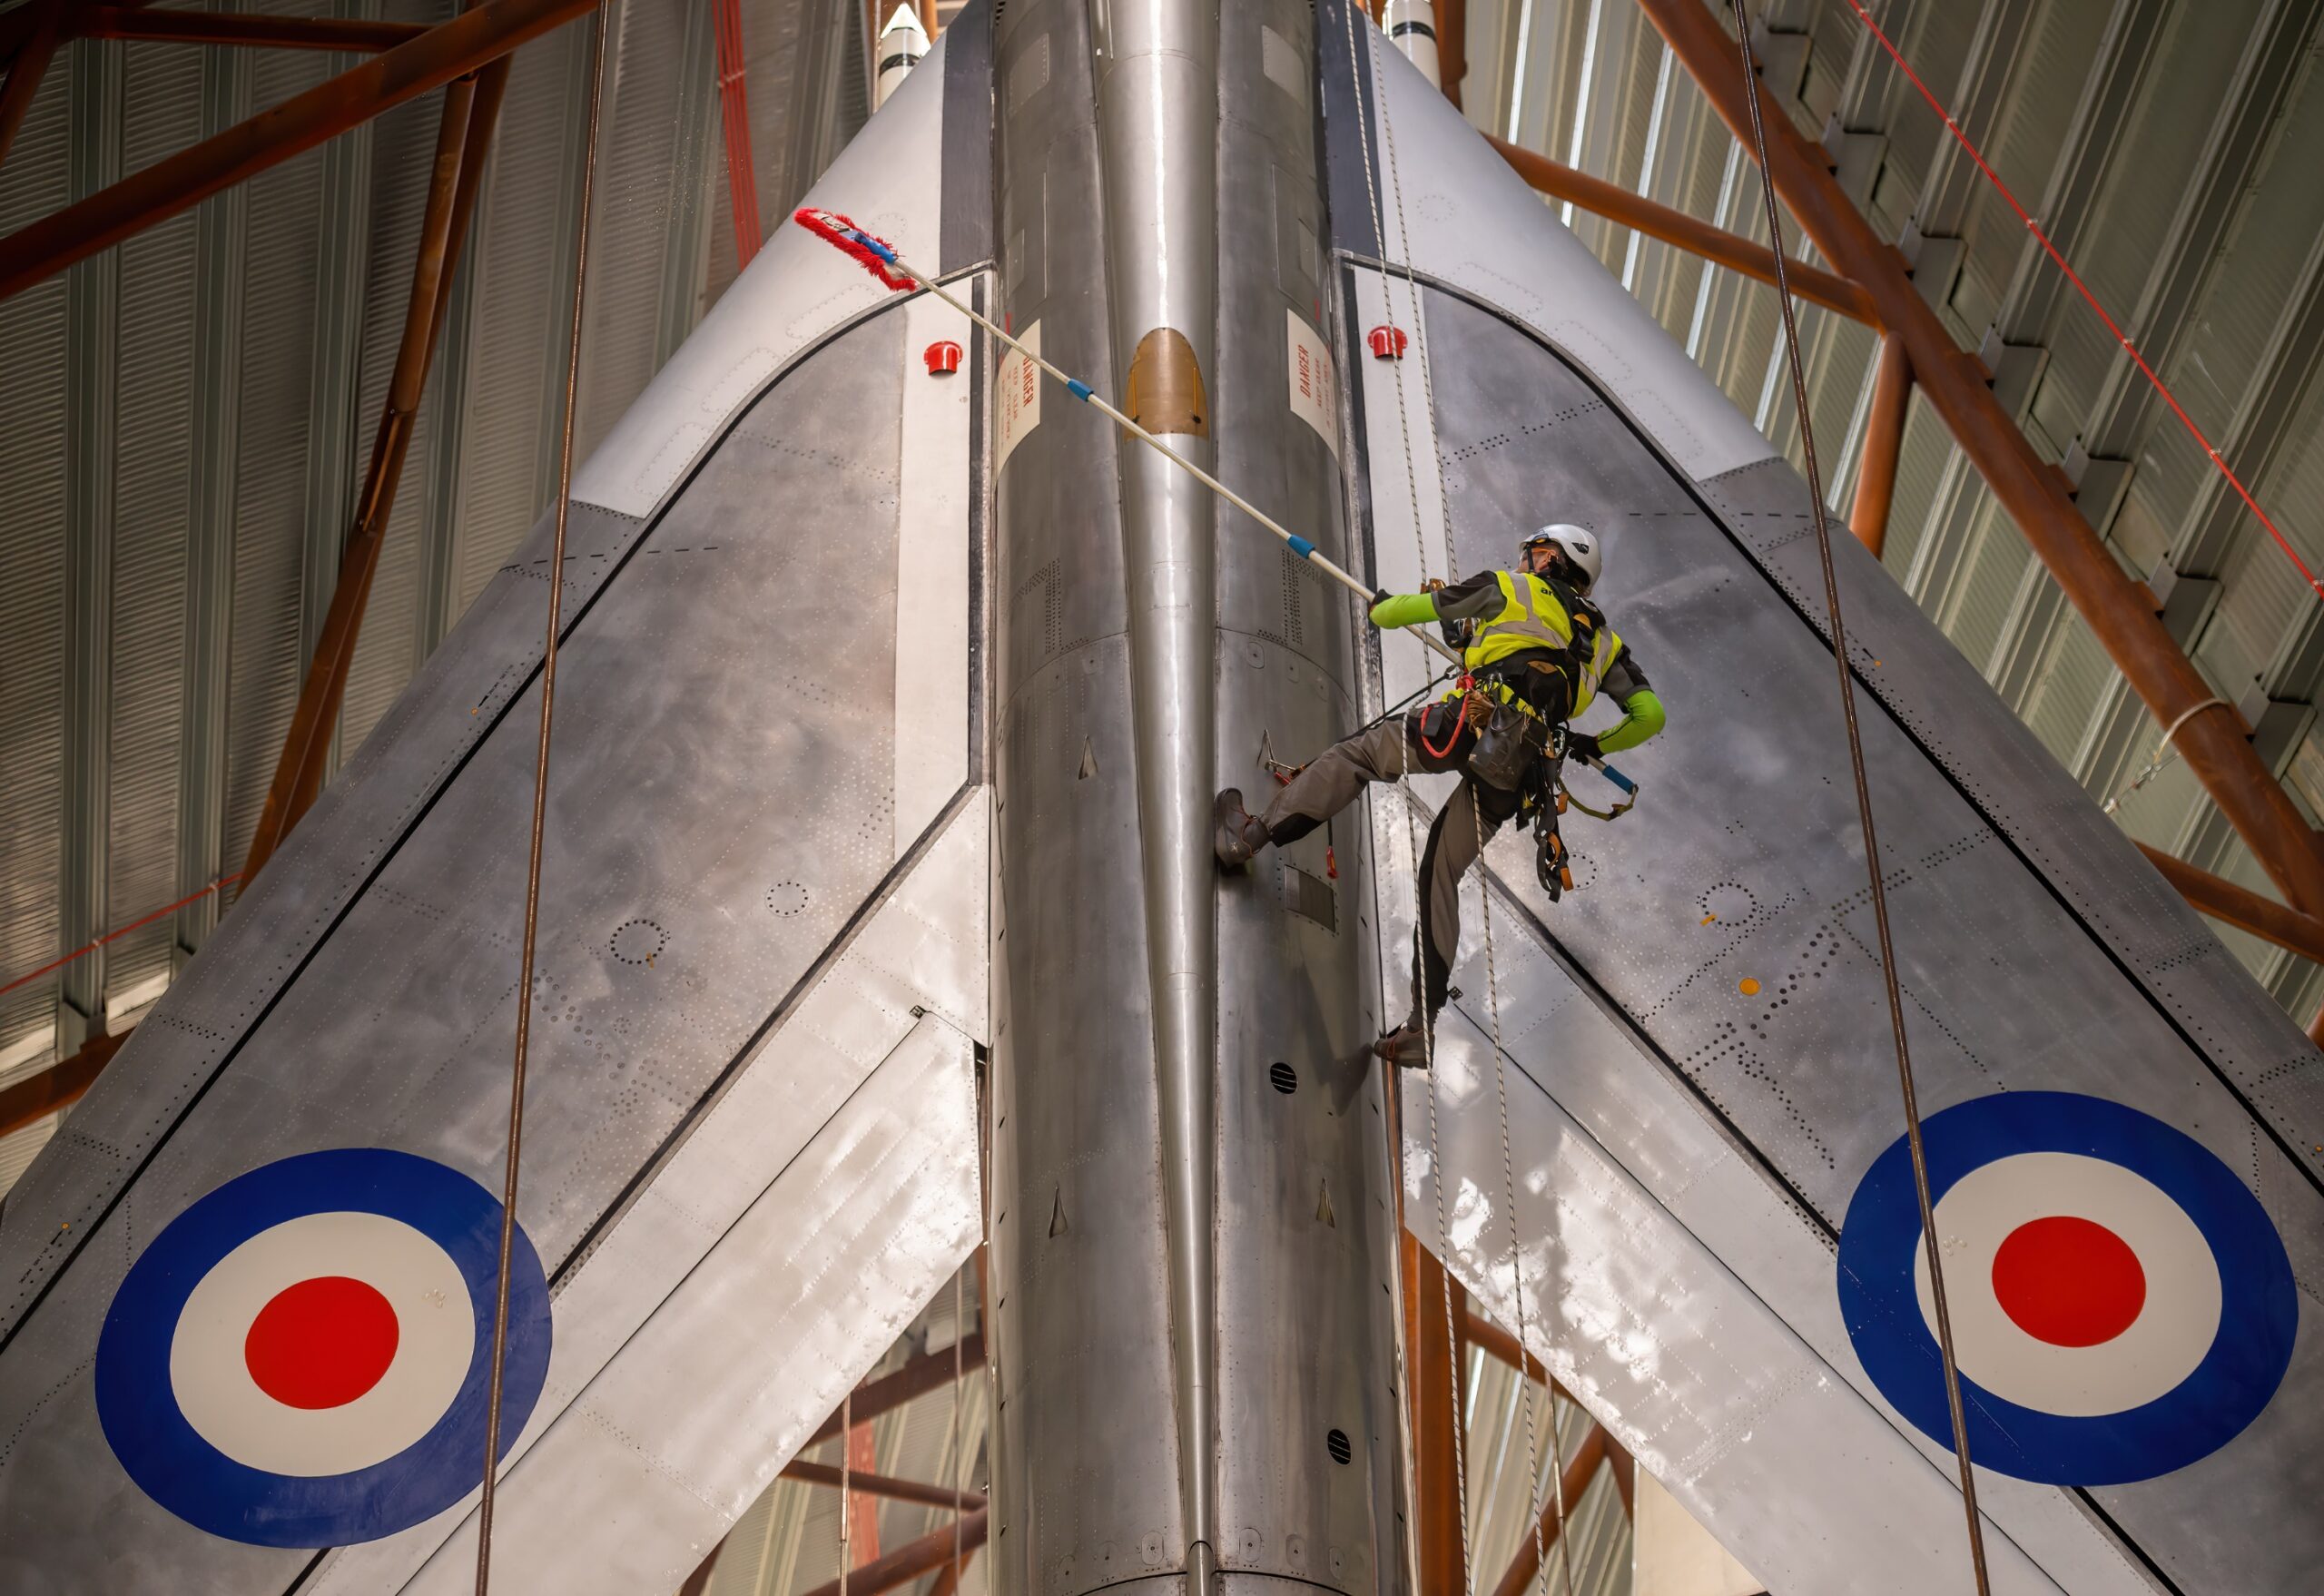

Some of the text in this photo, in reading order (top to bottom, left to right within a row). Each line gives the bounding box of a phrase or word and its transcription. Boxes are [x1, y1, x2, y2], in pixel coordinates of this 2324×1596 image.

[1023, 355, 1034, 408] DANGER
[1298, 344, 1311, 399] DANGER
[1541, 587, 1553, 596] ar
